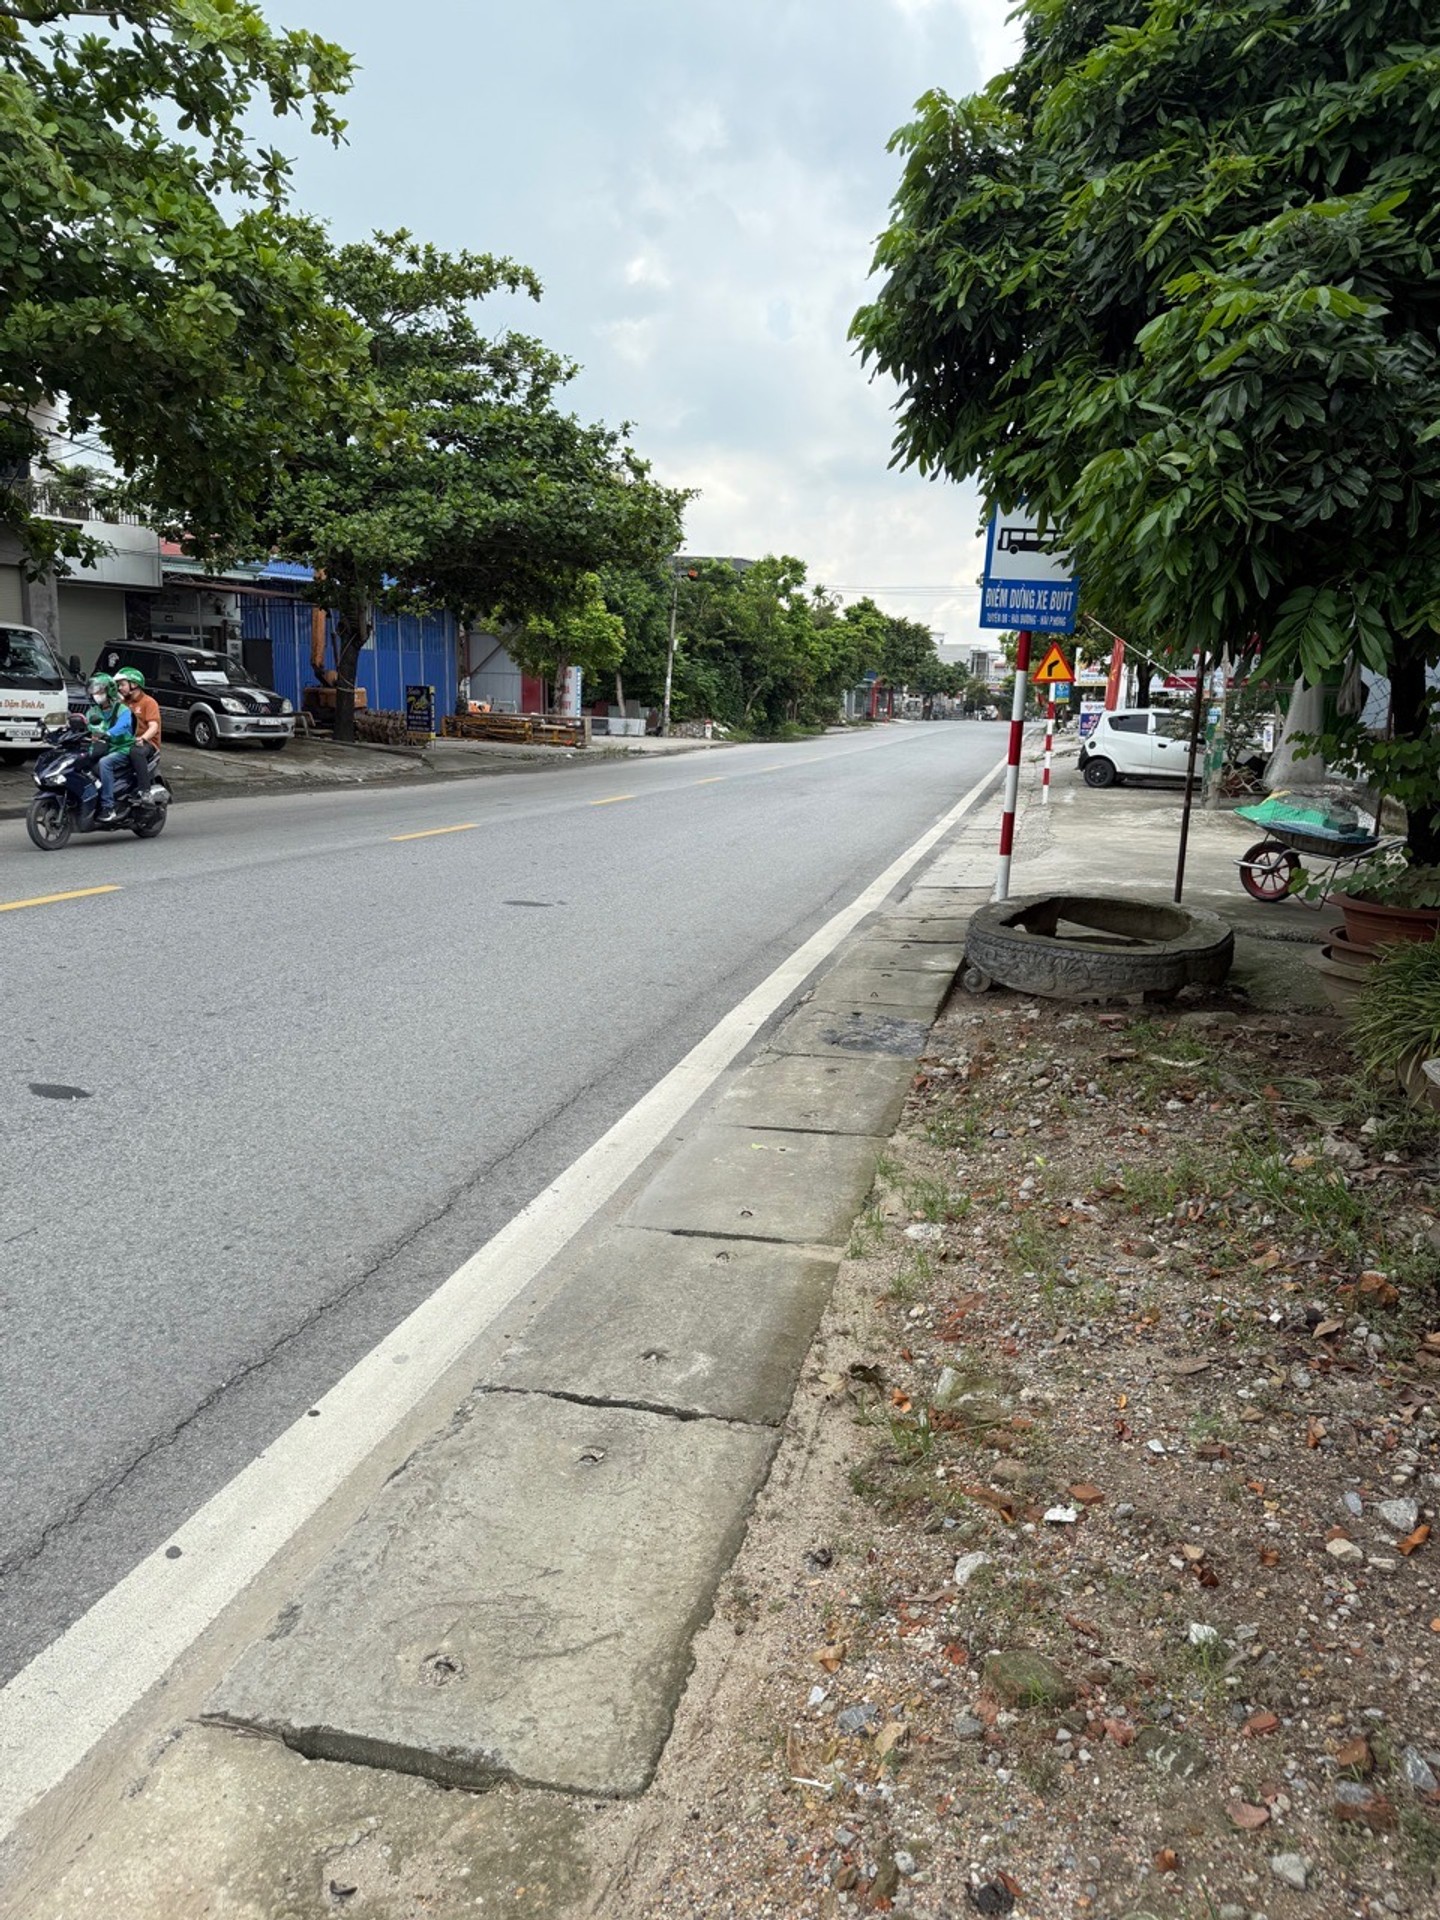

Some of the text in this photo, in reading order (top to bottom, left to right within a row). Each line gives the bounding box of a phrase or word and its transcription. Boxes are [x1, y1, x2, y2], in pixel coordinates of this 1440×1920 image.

[985, 581, 1008, 607] ĐIỂM
[1036, 588, 1049, 610] XE
[1049, 587, 1074, 611] BUÝT
